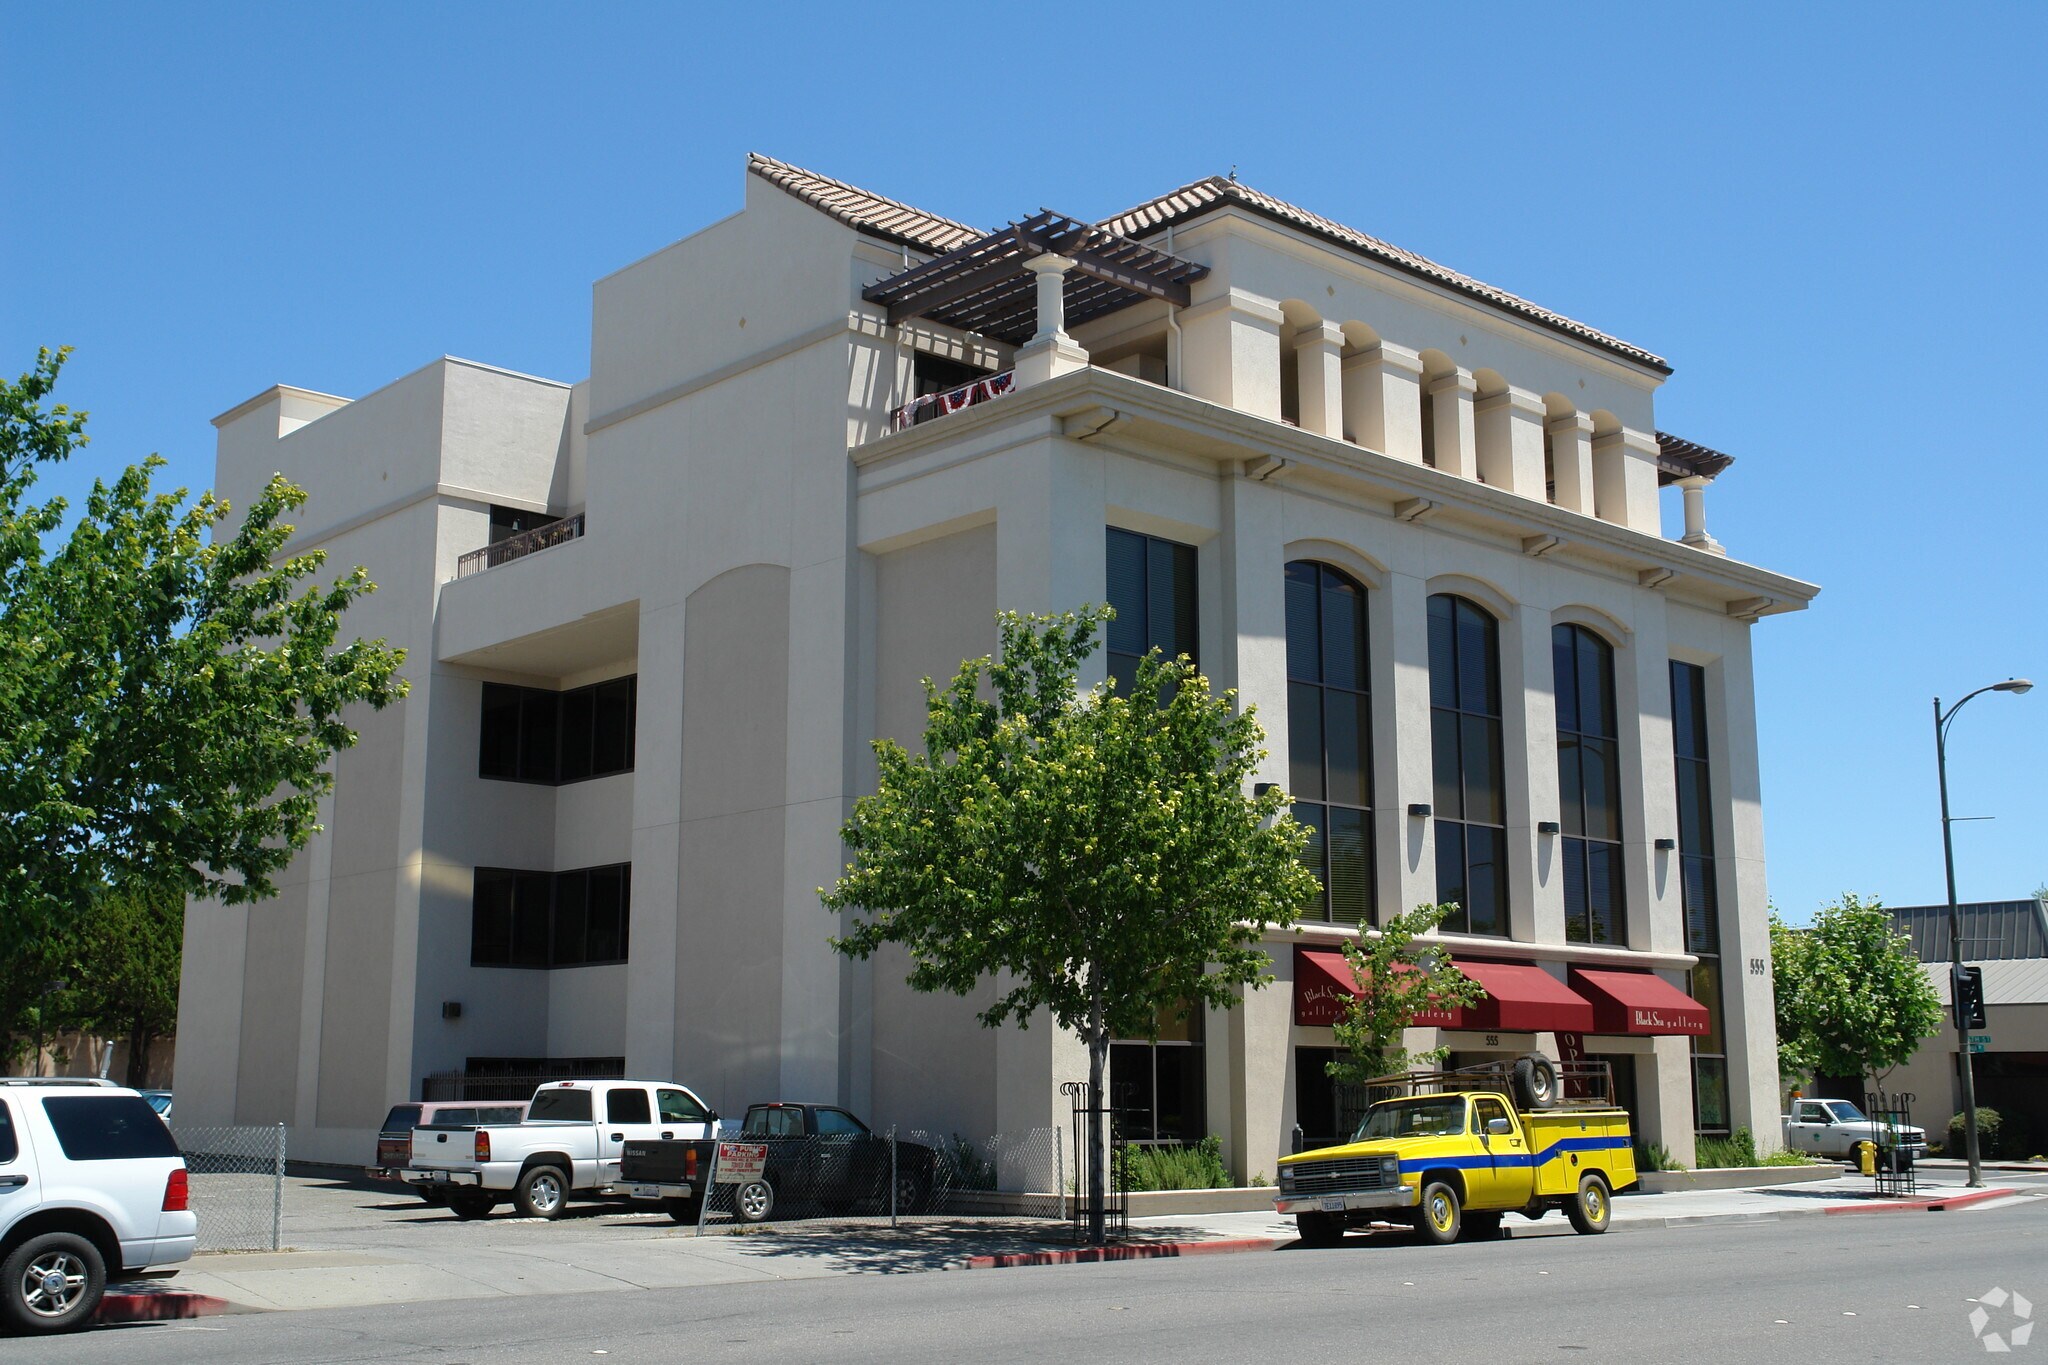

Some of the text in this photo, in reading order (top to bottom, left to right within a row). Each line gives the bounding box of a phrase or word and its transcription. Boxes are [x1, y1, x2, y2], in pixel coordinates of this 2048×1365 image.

[1750, 958, 1764, 975] 555
[1304, 984, 1326, 1003] Black
[1301, 1005, 1346, 1017] gallery
[1408, 1009, 1452, 1020] allery
[1635, 1010, 1703, 1030] Black Sea gallery
[1485, 1035, 1499, 1046] 555
